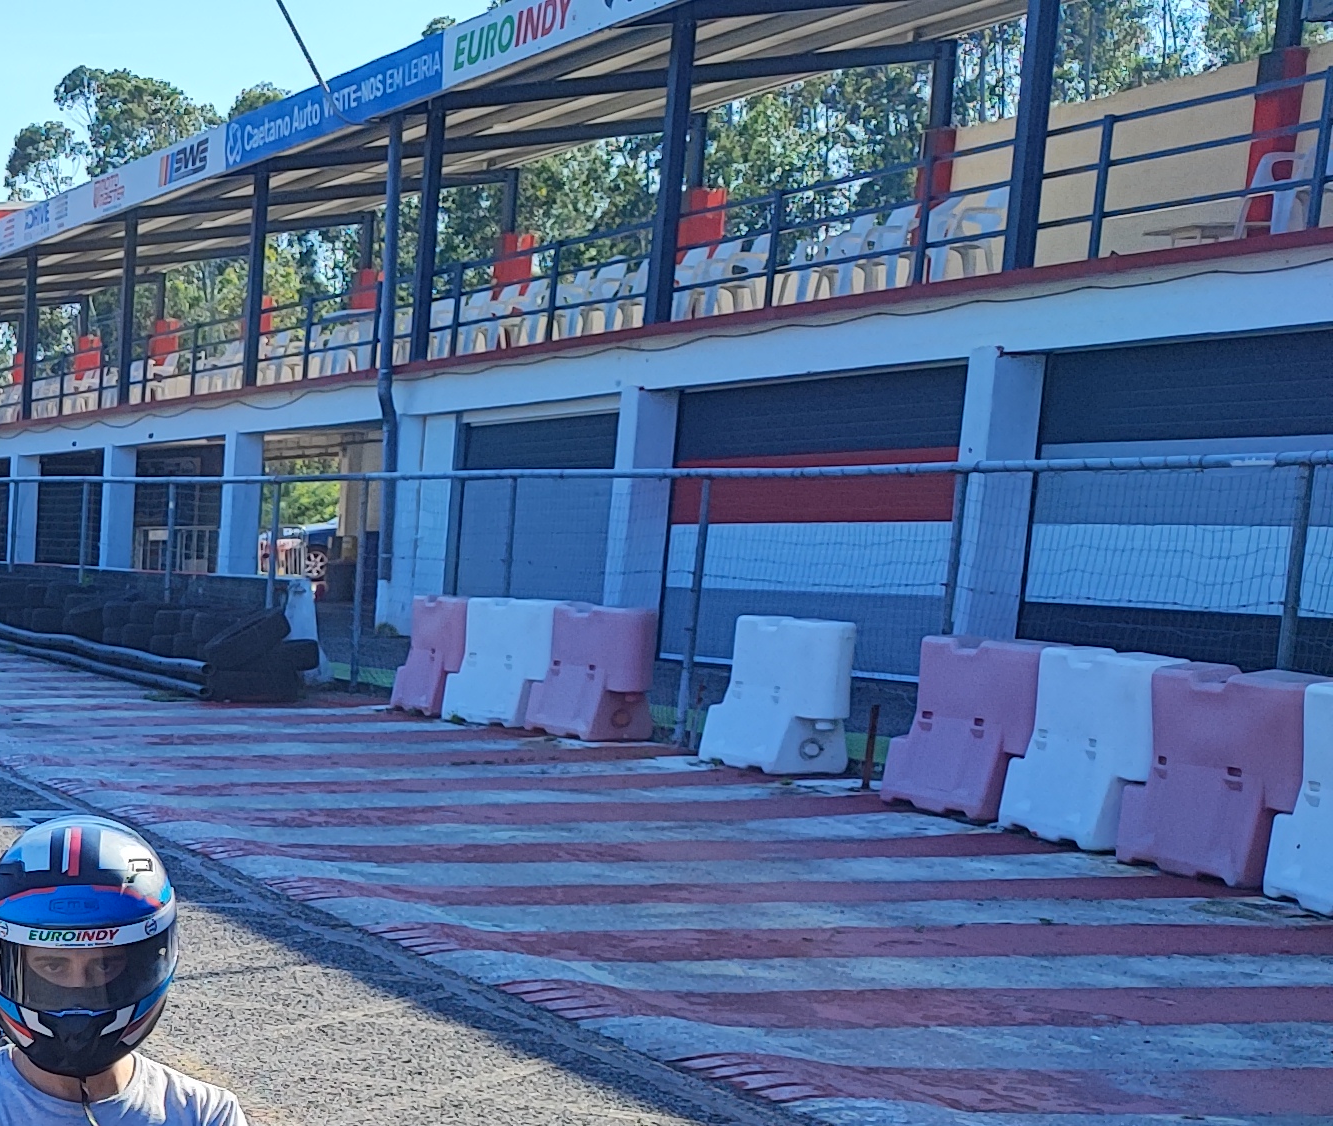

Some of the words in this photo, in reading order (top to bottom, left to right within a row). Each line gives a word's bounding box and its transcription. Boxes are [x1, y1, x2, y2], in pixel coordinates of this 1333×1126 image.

[453, 0, 573, 71] EUROINDY
[244, 115, 291, 151] Caetano
[292, 99, 321, 131] Auto
[386, 65, 403, 94] EM
[404, 50, 442, 86] LEIRIA
[174, 137, 210, 175] SWS
[28, 928, 120, 942] EUROINDY
